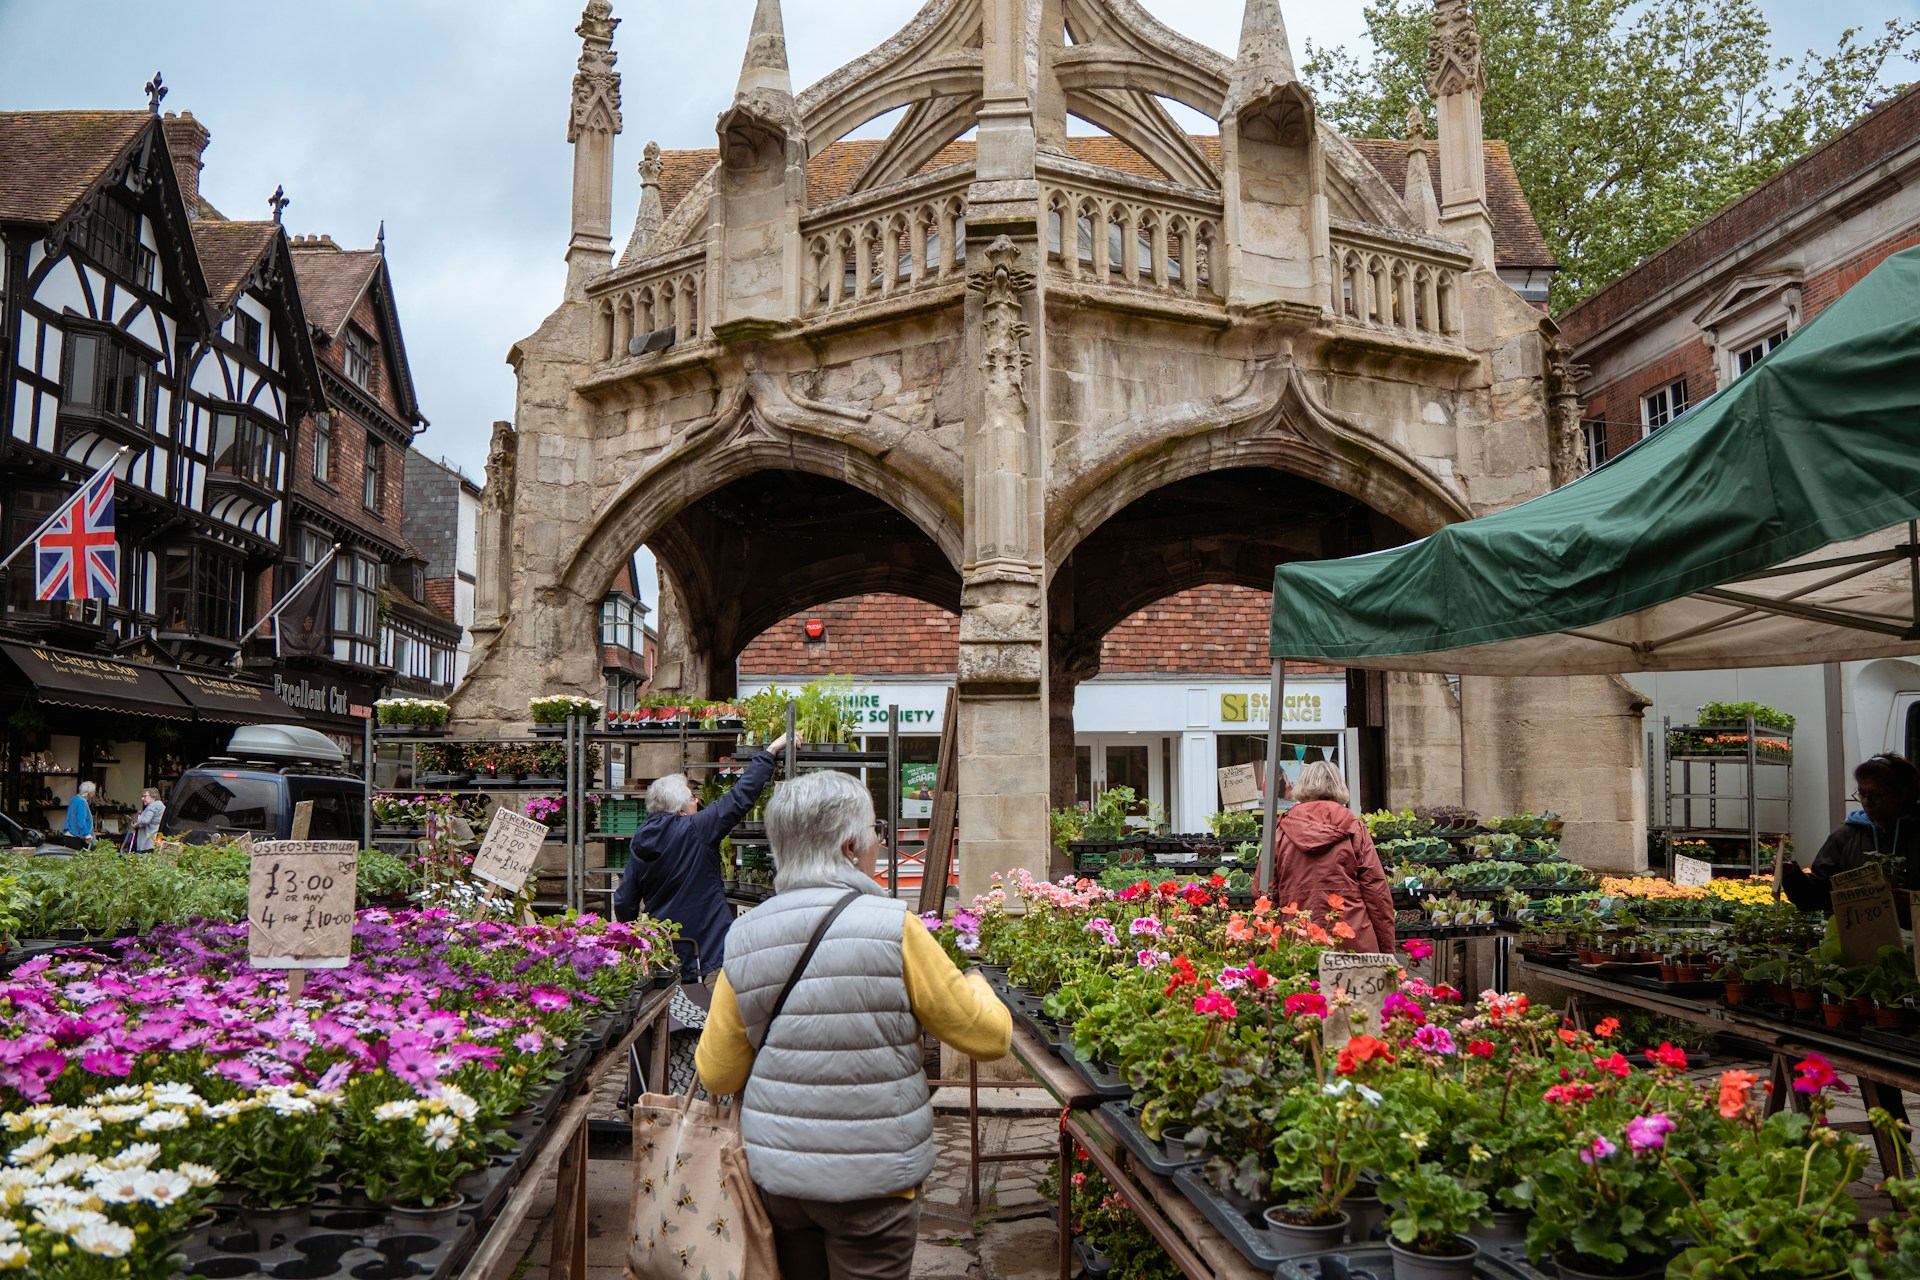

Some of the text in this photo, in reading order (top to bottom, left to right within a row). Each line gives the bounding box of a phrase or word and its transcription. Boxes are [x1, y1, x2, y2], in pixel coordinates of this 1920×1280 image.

[30, 647, 139, 677] W. Carter & Son
[273, 673, 347, 715] Excellent Cut
[1250, 692, 1321, 708] Starts
[1223, 694, 1248, 720] St
[868, 710, 935, 723] SOIETY
[253, 841, 355, 854] OSTEOSPERMUM
[482, 847, 491, 859] 2
[303, 893, 326, 903] ANY
[1836, 885, 1886, 901] MARROW
[261, 906, 277, 929] 4
[283, 914, 298, 923] FOR
[1323, 953, 1393, 967] GERANIUM
